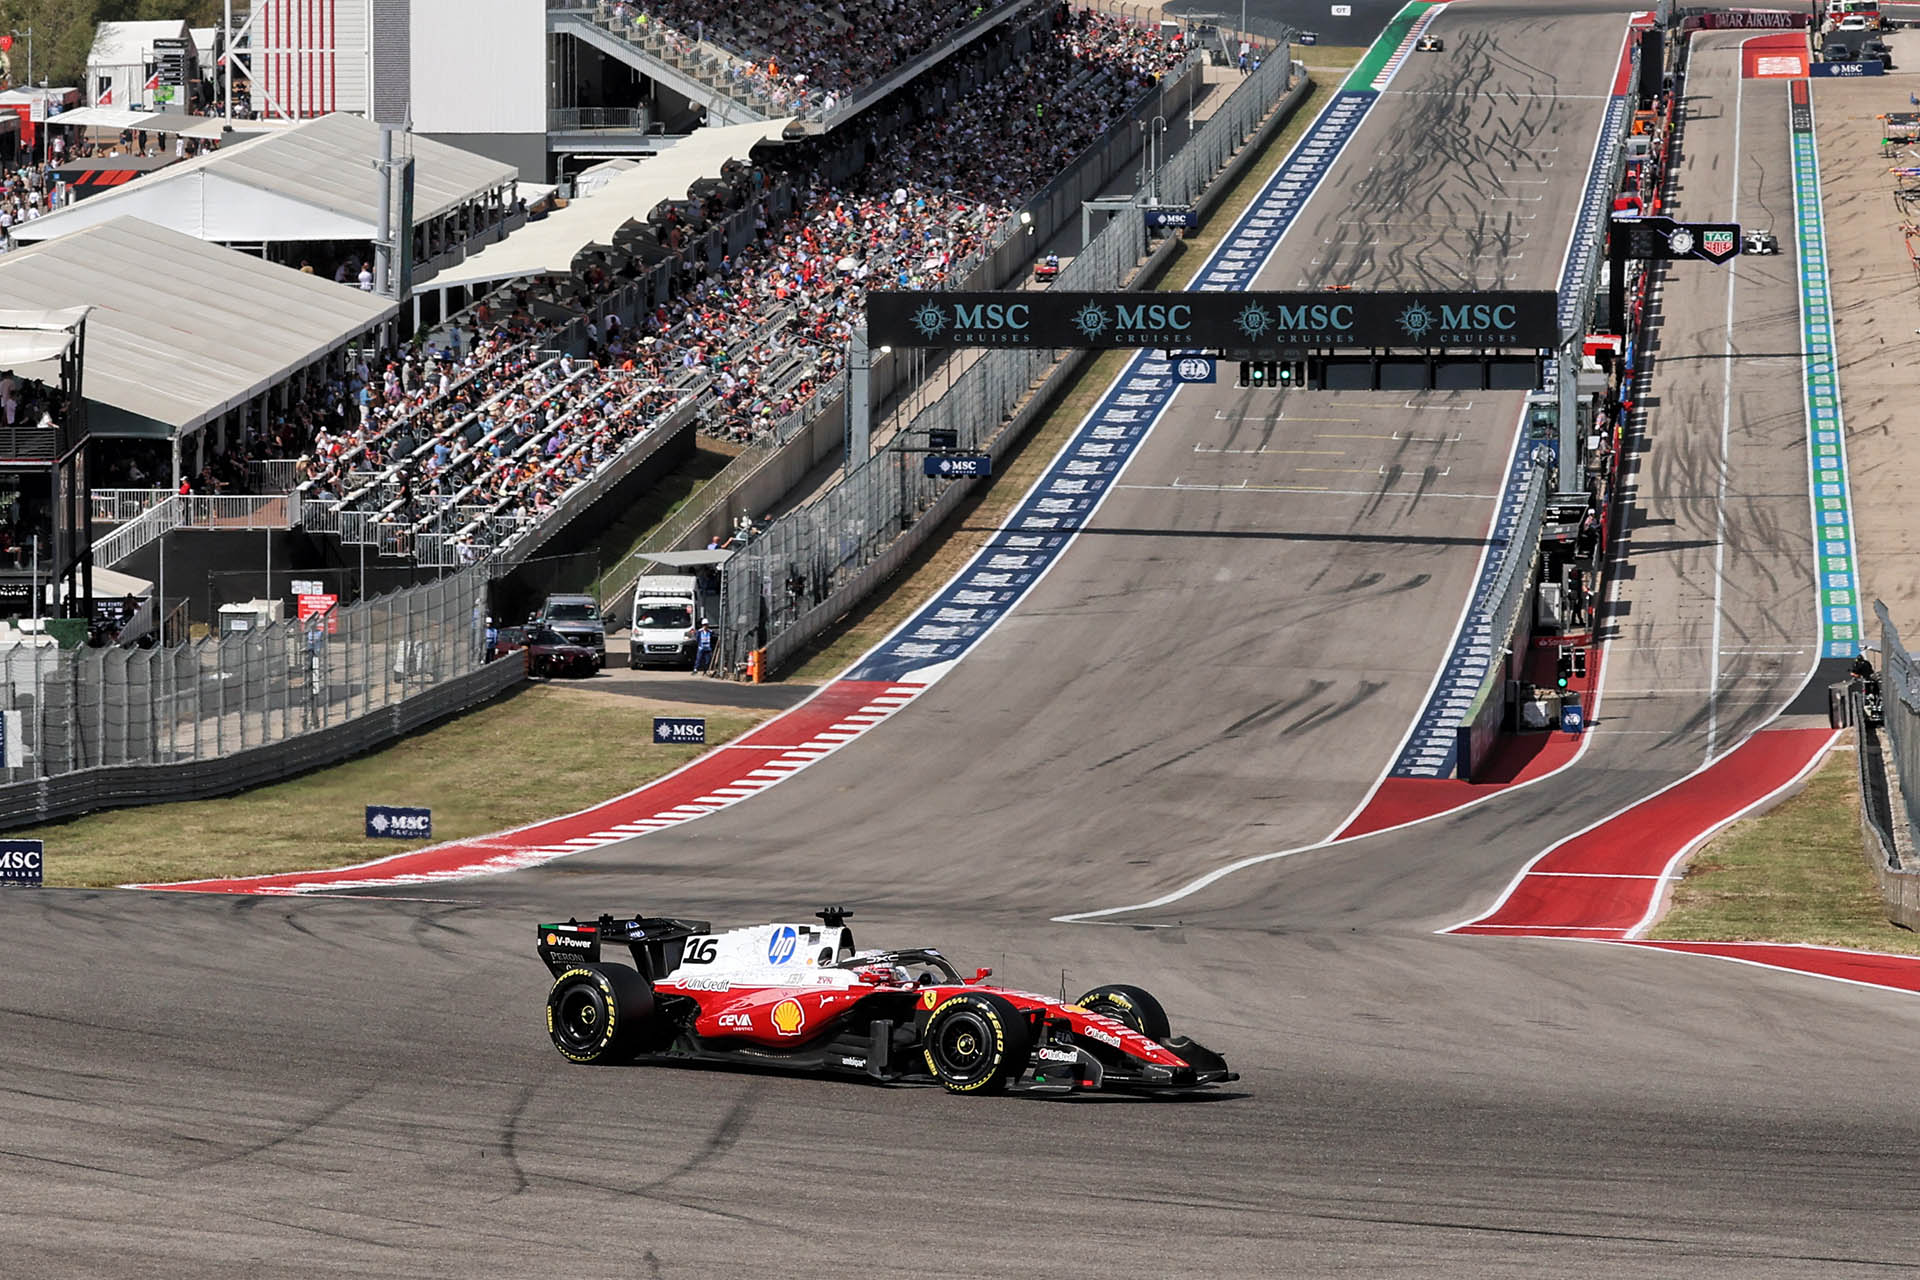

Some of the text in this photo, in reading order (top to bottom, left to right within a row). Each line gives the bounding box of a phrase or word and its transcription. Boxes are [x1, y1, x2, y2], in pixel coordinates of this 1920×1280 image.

[1746, 13, 1792, 28] AIRWAYS
[1841, 64, 1863, 73] MSC
[1167, 214, 1187, 223] MSC
[1705, 233, 1732, 241] TAG
[954, 304, 1029, 330] MSC
[1115, 304, 1191, 330] MSC
[1277, 304, 1353, 330] MSC
[1439, 304, 1516, 330] MSC
[954, 334, 1030, 342] CRUISES
[1115, 334, 1192, 342] CRUISES
[1277, 334, 1354, 342] CRUISES
[1439, 334, 1517, 342] CRUISES
[1181, 361, 1207, 377] FIA
[952, 461, 976, 470] MSC
[673, 724, 703, 736] MSC
[390, 816, 428, 830] MSC
[556, 936, 592, 948] V-Power
[769, 926, 796, 965] hp
[550, 951, 585, 962] PERONI
[682, 938, 719, 965] 16
[687, 978, 730, 991] UniCredit
[605, 995, 616, 1038] ZERO
[986, 1011, 1004, 1053] ZERO
[1092, 1029, 1121, 1047] UniCredit
[1047, 1050, 1078, 1062] UniCredit
